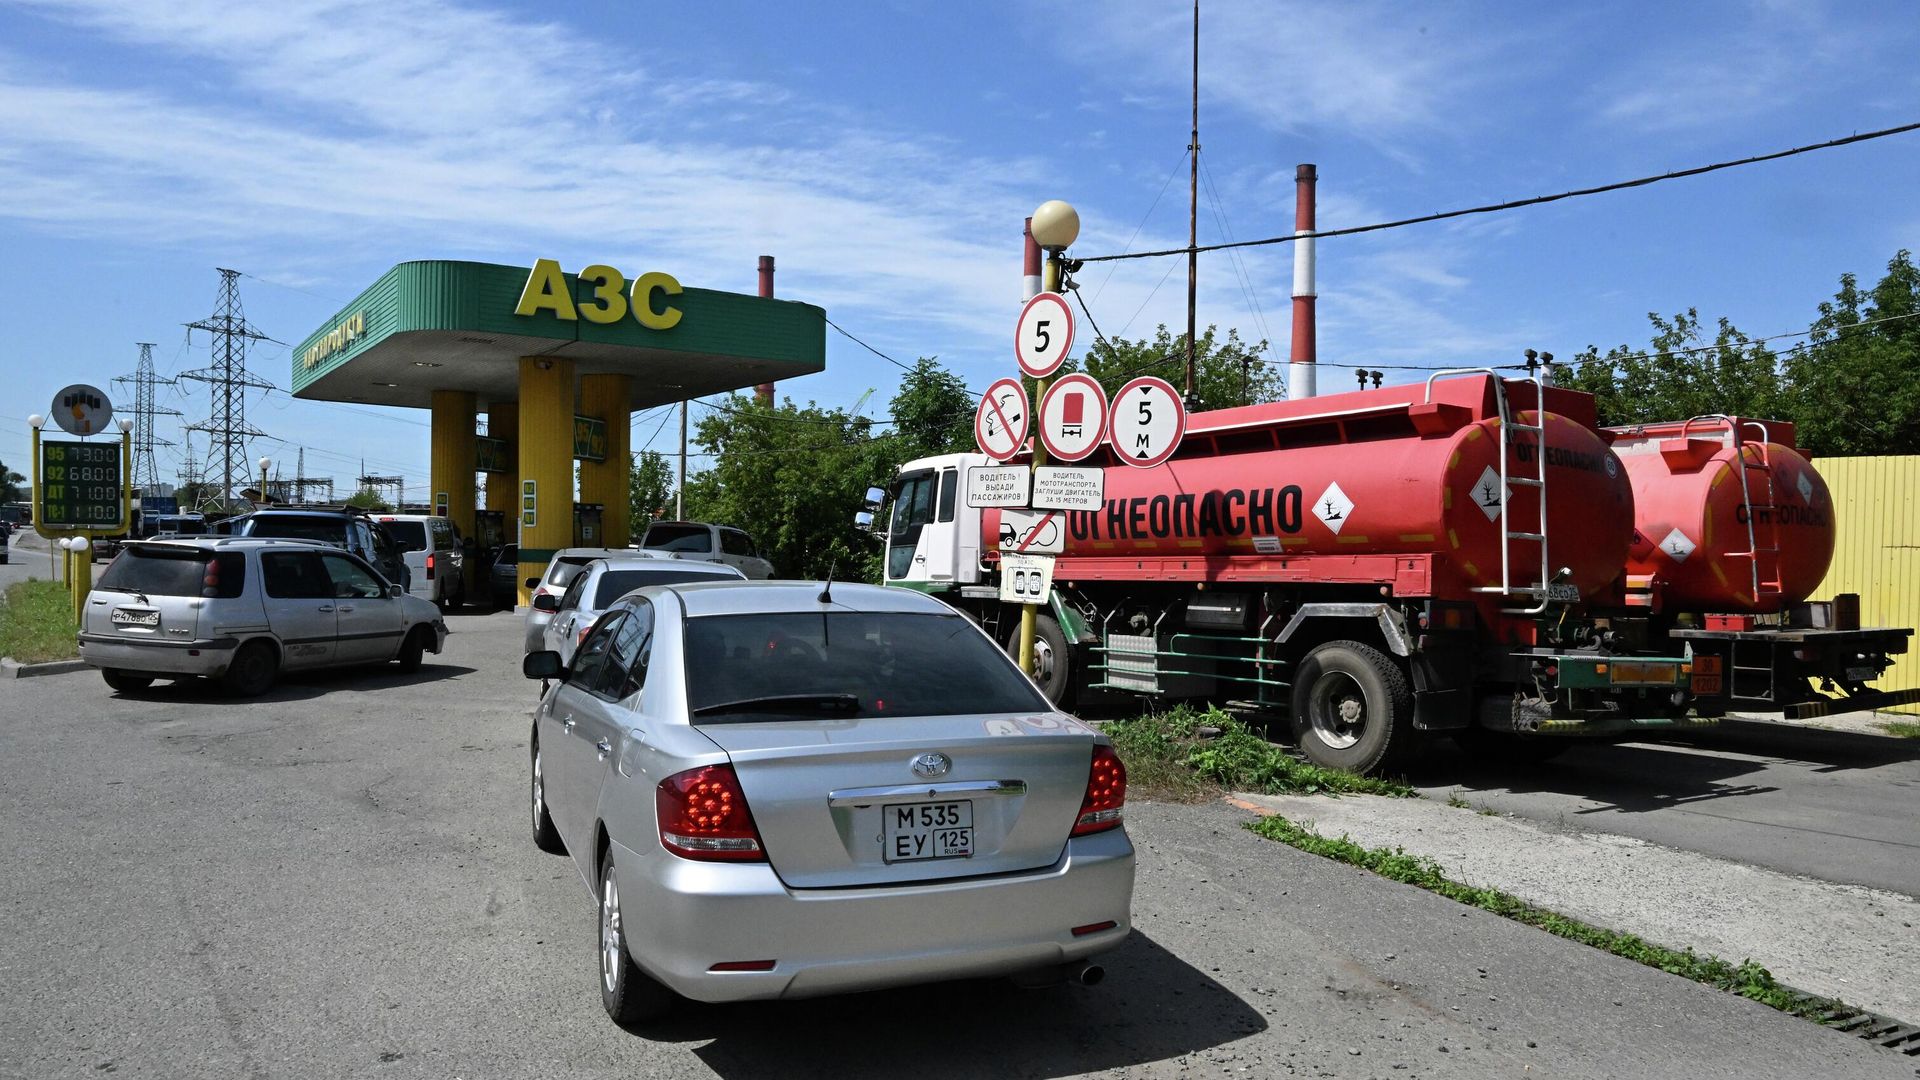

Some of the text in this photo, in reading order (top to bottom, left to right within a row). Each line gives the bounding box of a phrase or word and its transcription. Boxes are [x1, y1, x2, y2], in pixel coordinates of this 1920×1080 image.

[1034, 320, 1050, 353] 5
[1138, 401, 1152, 426] 5
[47, 446, 64, 461] 95
[47, 466, 116, 481] 92 68.00
[1053, 472, 1085, 480] ВОДИТЕЛЬ
[985, 483, 1014, 491] ВЫСАДИ
[1040, 480, 1097, 488] МОТОТРАНСПОРТА
[47, 485, 65, 499] ДТ
[1034, 487, 1101, 497] ЗАГЛУШИ ДВИГАТЕЛЬ
[1069, 484, 1303, 542] ОГНЕОПАСНО
[897, 804, 960, 829] М 535
[940, 830, 969, 848] 125
